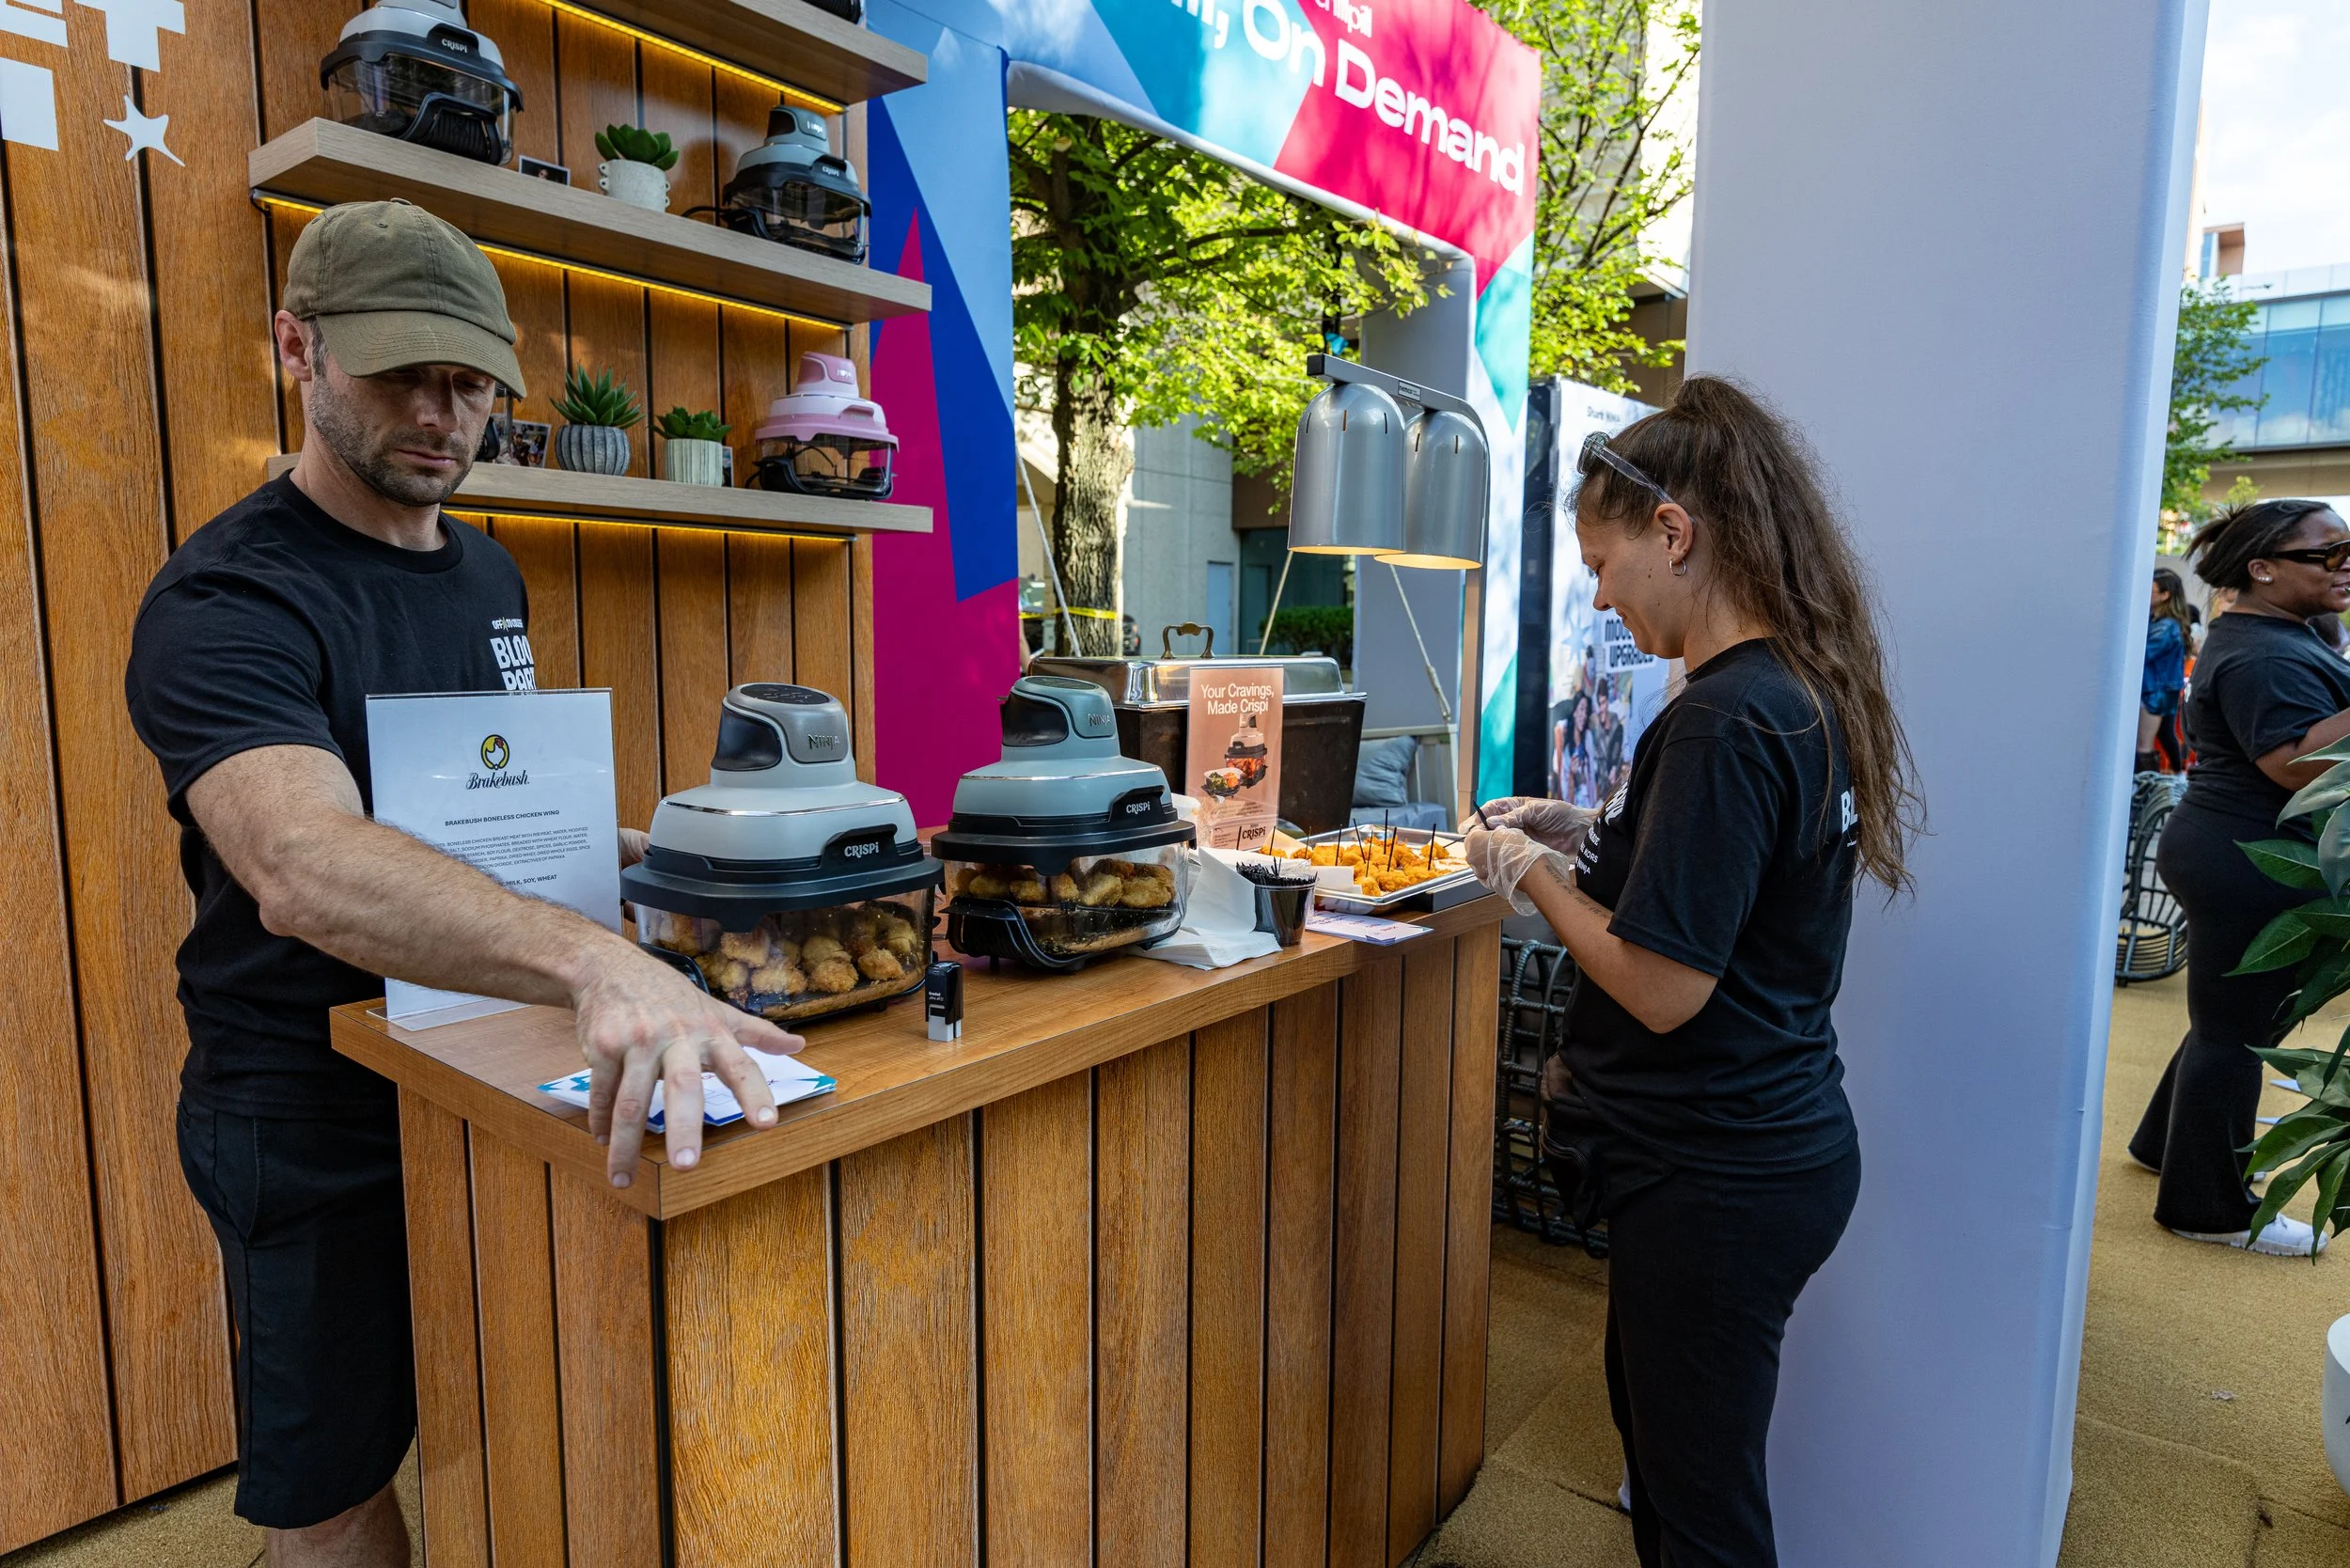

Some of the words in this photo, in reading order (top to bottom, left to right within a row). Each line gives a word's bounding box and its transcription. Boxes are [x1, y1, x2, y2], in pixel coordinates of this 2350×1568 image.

[1242, 0, 1326, 87] On
[1335, 38, 1526, 196] Demand
[1200, 683, 1226, 699] Your
[1228, 682, 1275, 699] Cravings,
[1207, 699, 1238, 714] Made
[1240, 698, 1269, 714] Crispi
[1088, 713, 1112, 727] NINJA
[807, 733, 840, 750] NINJA
[445, 816, 482, 826] BRAKEBUSH
[483, 814, 515, 823] BONELESS
[515, 811, 542, 820] CHICKEN
[1583, 848, 1599, 864] KORS
